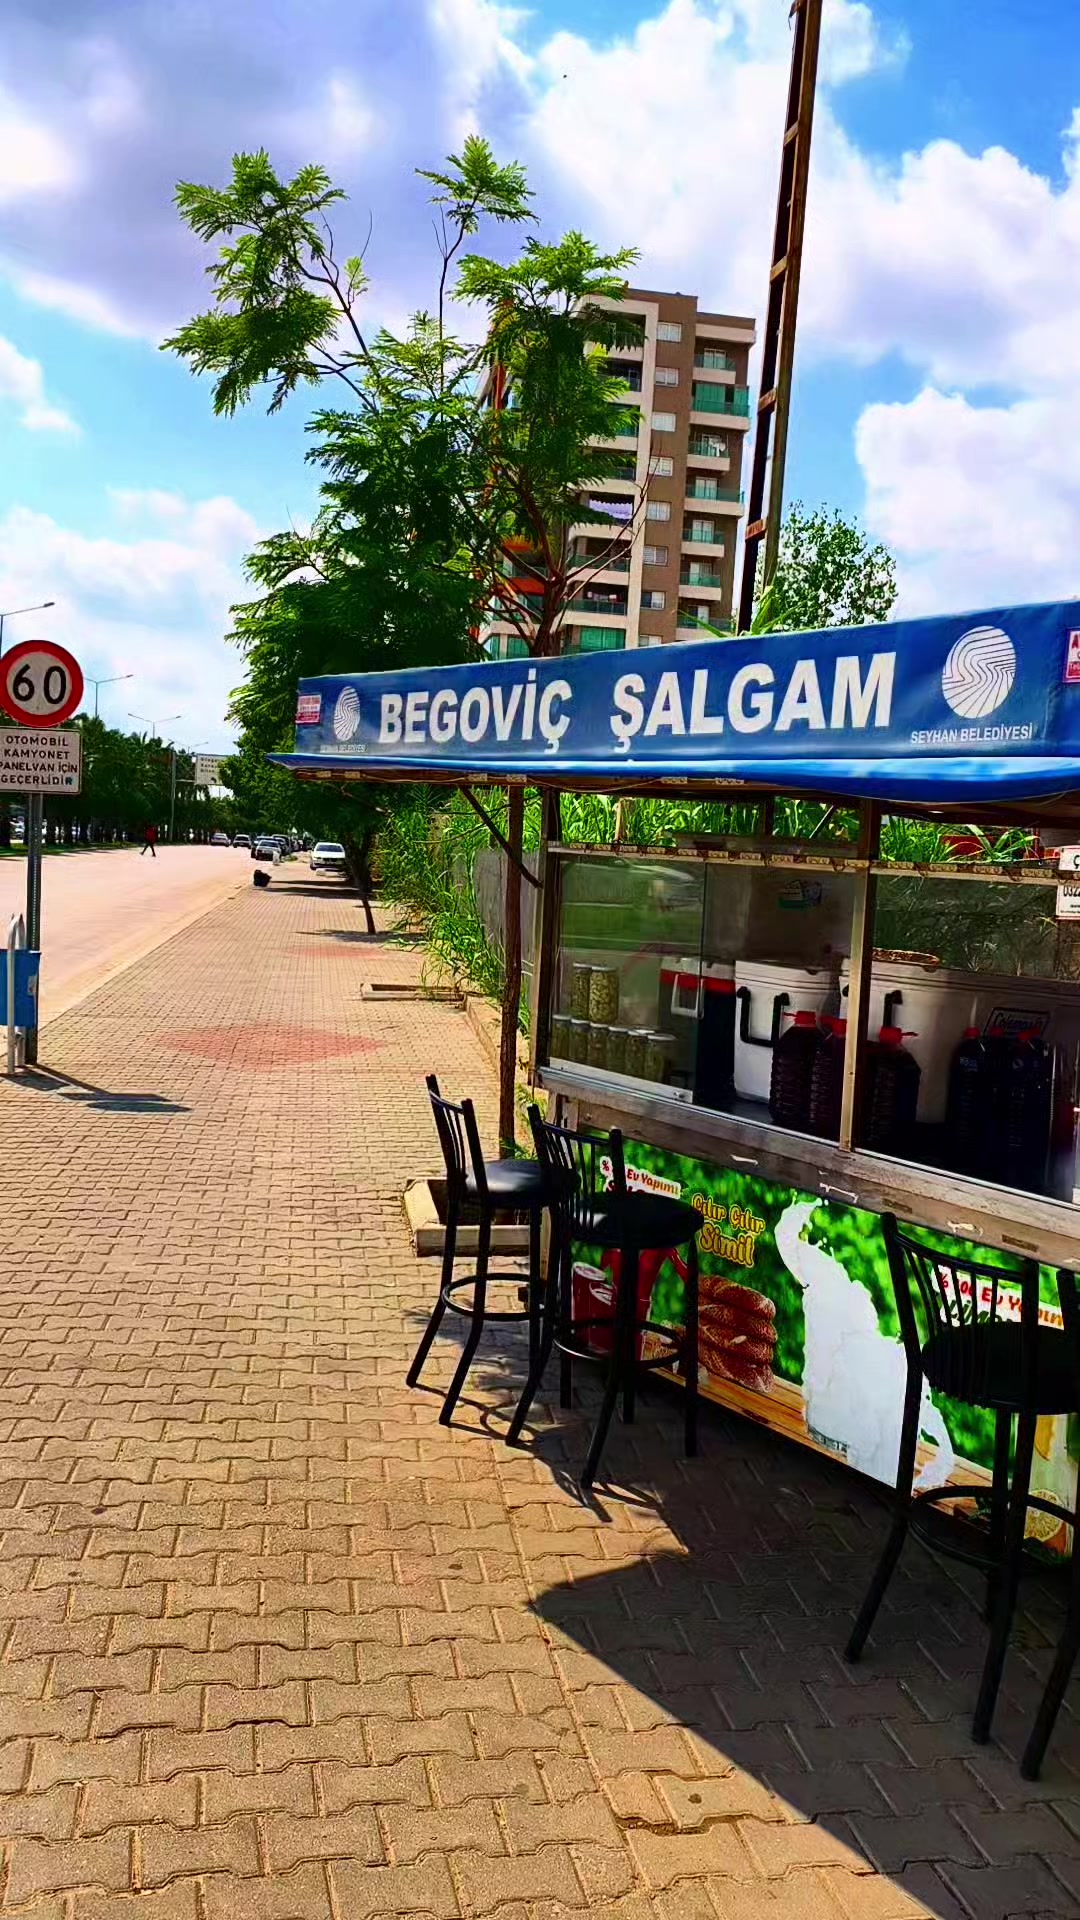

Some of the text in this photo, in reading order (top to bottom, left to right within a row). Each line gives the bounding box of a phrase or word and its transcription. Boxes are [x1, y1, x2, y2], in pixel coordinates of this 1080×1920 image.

[13, 664, 66, 704] 60
[379, 652, 896, 754] BEGOVİÇ ŞALGAM
[6, 735, 69, 747] OTOMOBİL
[911, 722, 1033, 744] SEYHAN BELEDİYESİ
[4, 749, 70, 760] KAMYONET
[58, 763, 78, 774] İÇİN
[1, 774, 73, 786] GEÇERLİDİR
[627, 1168, 639, 1181] Ev
[641, 1173, 679, 1195] Yapımı
[701, 1222, 753, 1267] Simit
